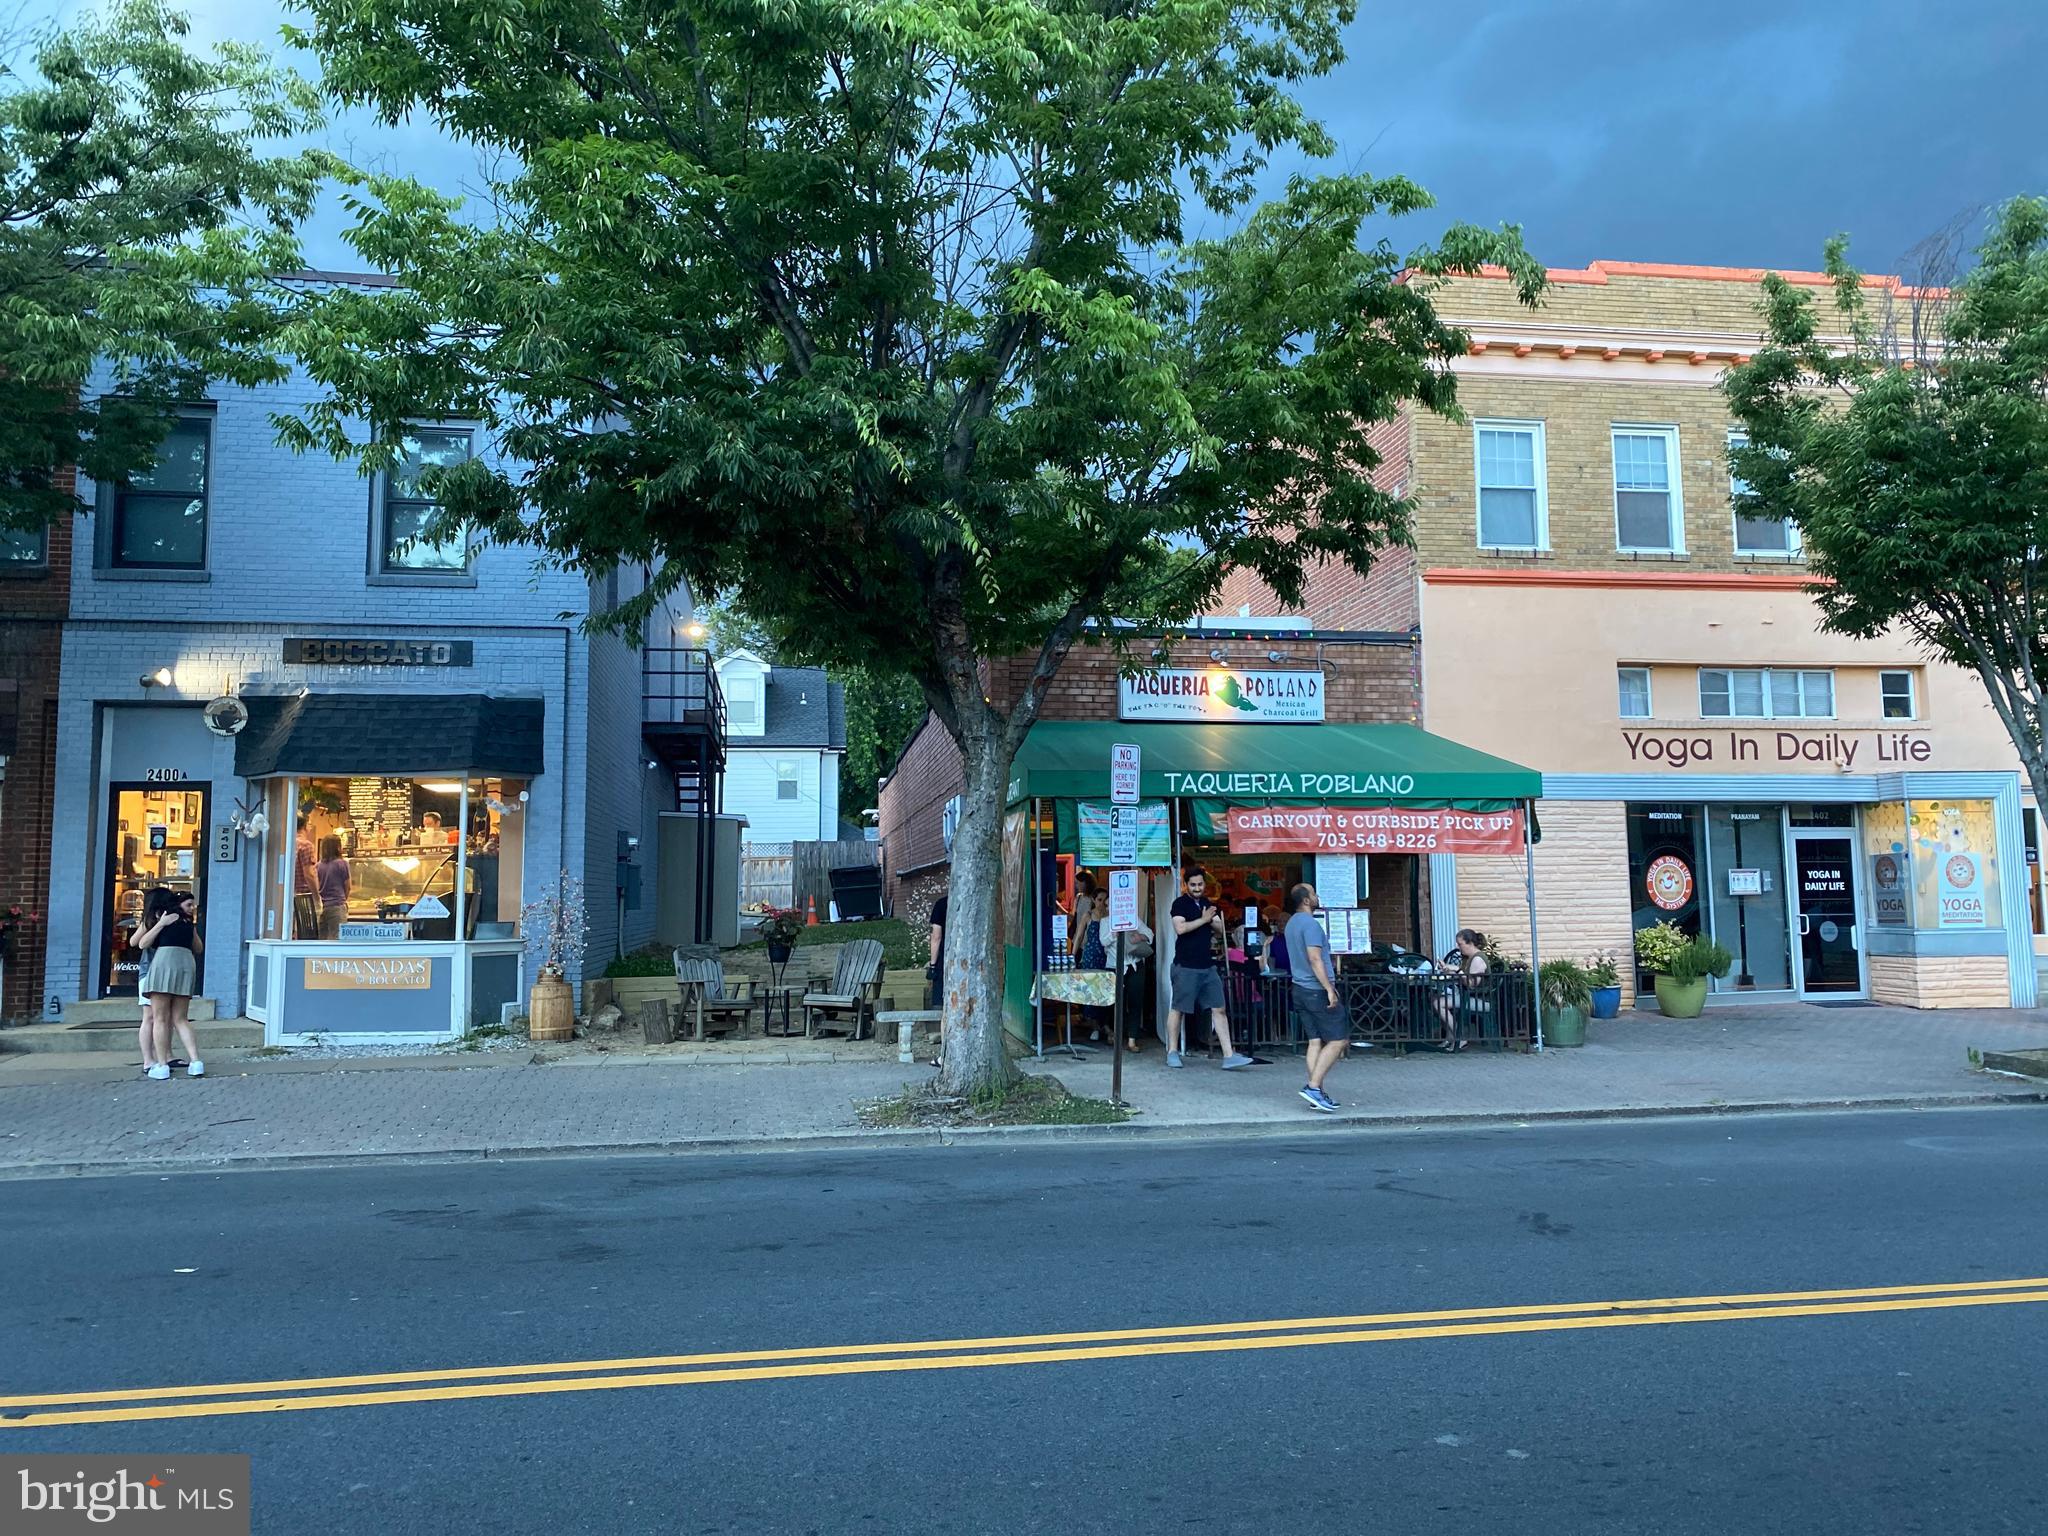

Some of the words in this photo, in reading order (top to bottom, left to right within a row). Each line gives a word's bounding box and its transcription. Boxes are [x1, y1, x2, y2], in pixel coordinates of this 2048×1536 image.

[301, 640, 451, 663] BOCCATO
[1128, 674, 1210, 697] TAQUERIA
[1275, 700, 1306, 708] Mexican
[1263, 709, 1297, 717] Charcoal
[1300, 709, 1319, 717] Grill
[1119, 749, 1132, 761] NO
[1623, 732, 1713, 768] Yoga
[1731, 732, 1759, 760] In
[1776, 732, 1859, 766] Daily
[1877, 733, 1931, 762] Life
[1114, 761, 1137, 771] PARKING
[147, 768, 179, 781] 2400
[1114, 773, 1128, 782] HERE
[1129, 773, 1137, 782] TO
[1164, 773, 1294, 795] TAQUERIA
[1300, 773, 1414, 795] POBLANO
[1648, 812, 1682, 820] MEDITATION
[1943, 807, 1960, 816] YOGA
[1112, 811, 1118, 825] 2
[1238, 814, 1333, 829] CARRYOUT
[1336, 816, 1348, 828] &
[1352, 814, 1440, 829] CURBSIDE
[1444, 815, 1485, 831] PICK
[1489, 817, 1513, 830] UP
[1317, 832, 1437, 849] 703-548-8226
[1807, 870, 1830, 879] YOGA
[1831, 870, 1841, 879] IN
[1804, 882, 1828, 891] DAILY
[1828, 882, 1845, 891] LIFE
[1876, 899, 1905, 911] YOGA
[1942, 899, 1982, 910] YOGA
[374, 927, 403, 937] GELATOS
[113, 962, 140, 971] Welco
[311, 960, 426, 973] EMPANADAS
[369, 975, 425, 985] BOCCATO
